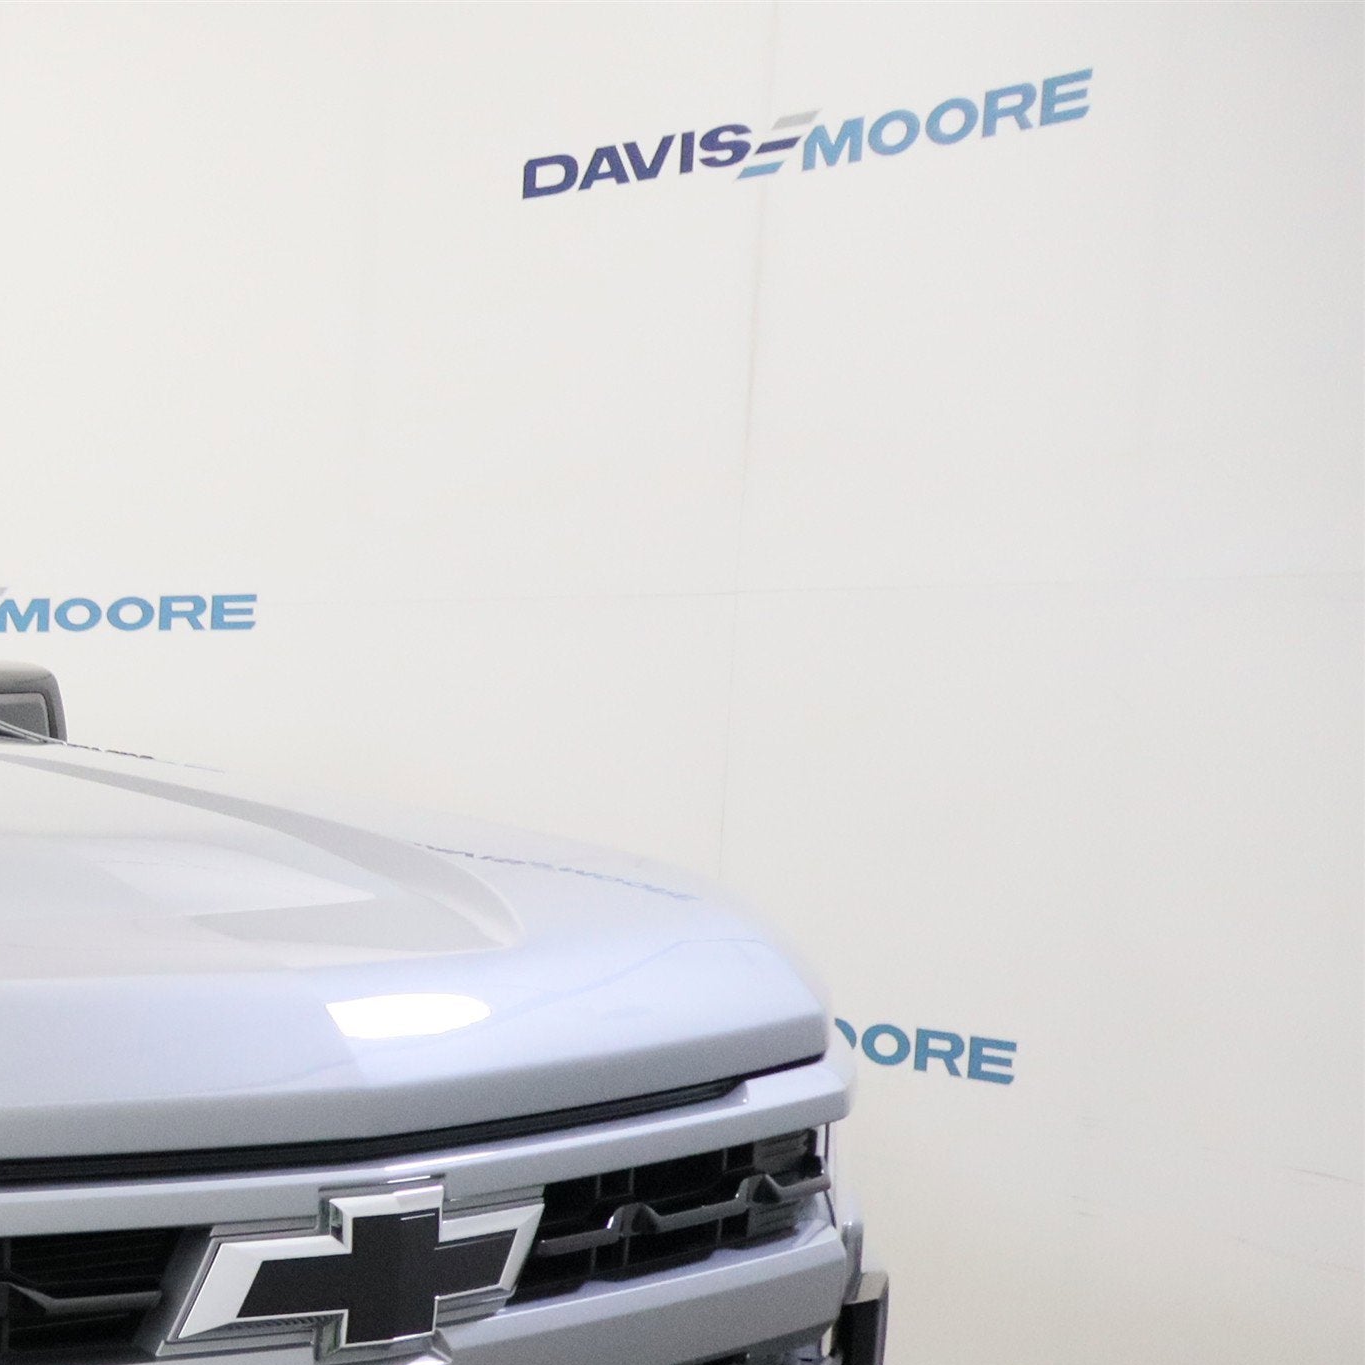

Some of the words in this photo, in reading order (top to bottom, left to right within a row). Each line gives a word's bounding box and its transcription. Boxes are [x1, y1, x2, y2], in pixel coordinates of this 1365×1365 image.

[522, 123, 753, 200] DAVIS
[801, 67, 1094, 172] MOORE
[834, 1017, 1017, 1086] ORE
